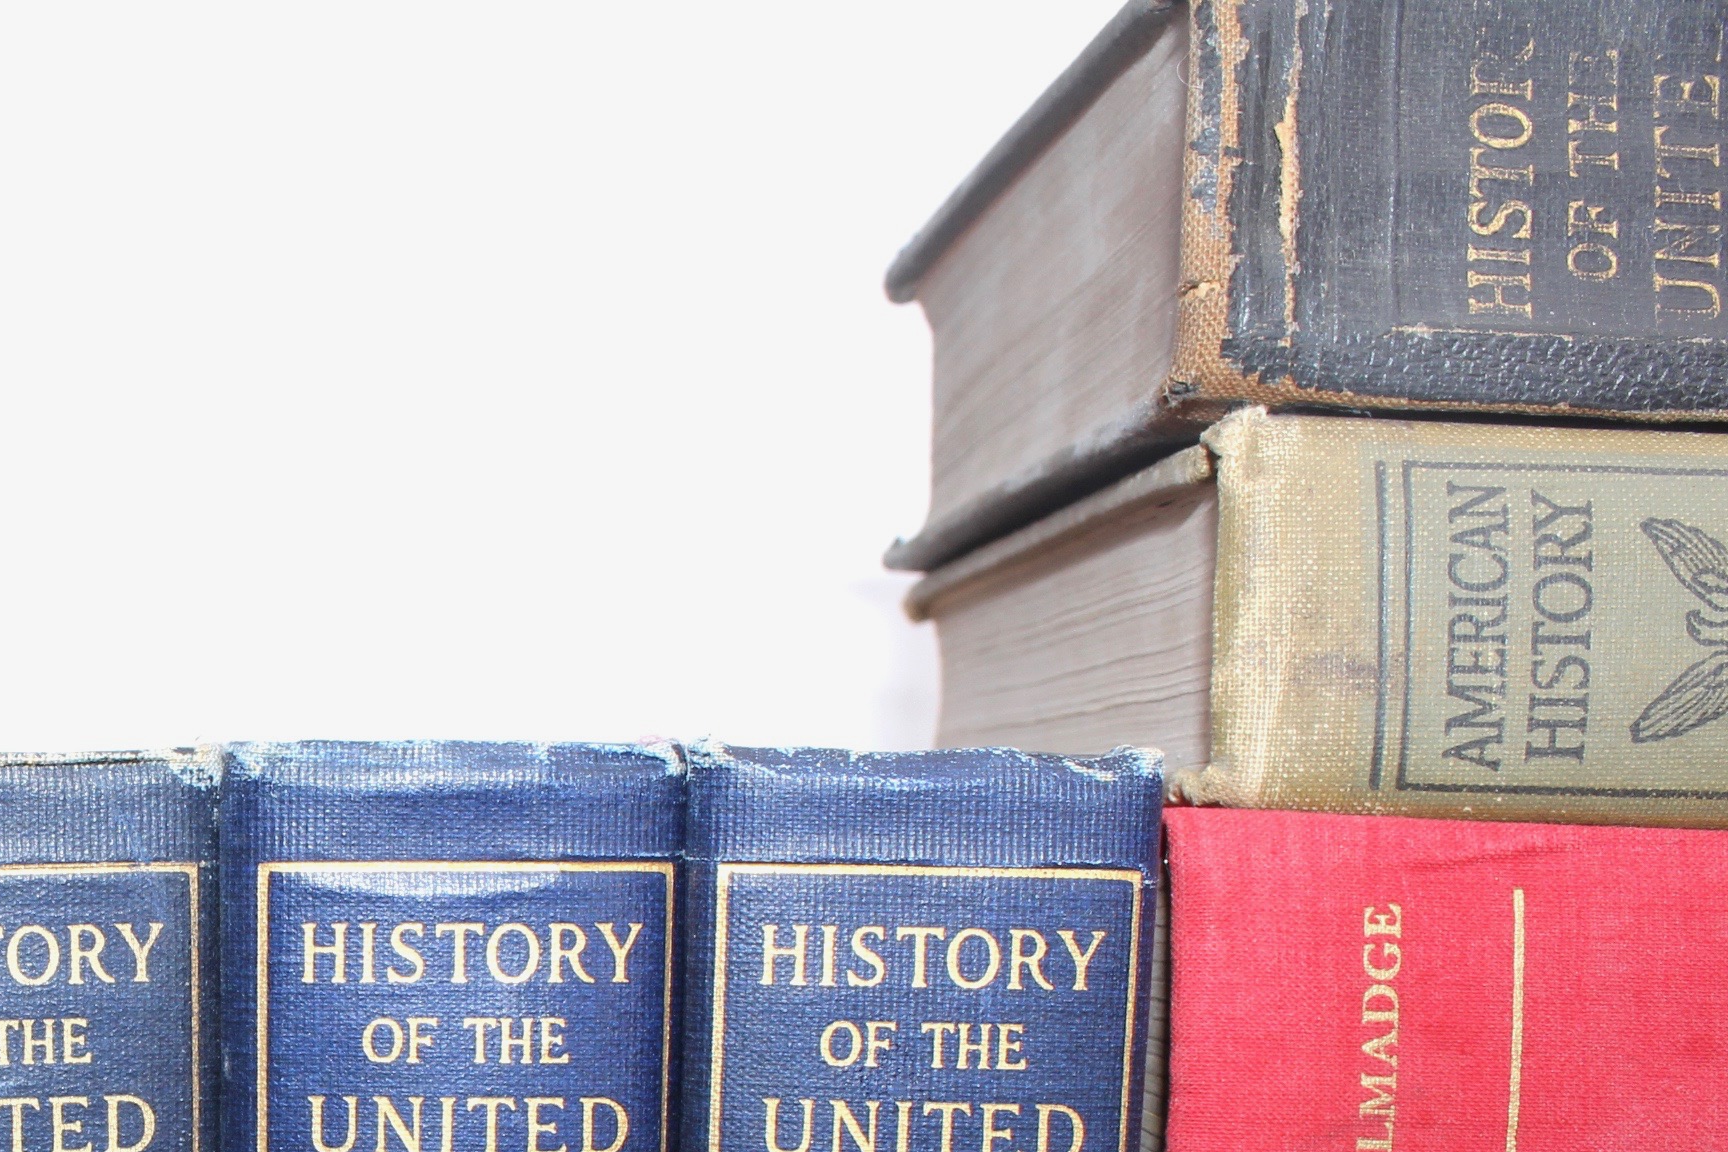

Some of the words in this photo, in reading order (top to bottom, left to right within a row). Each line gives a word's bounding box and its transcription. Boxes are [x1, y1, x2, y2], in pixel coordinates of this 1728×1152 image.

[1567, 48, 1620, 178] THE
[1467, 34, 1535, 320] HISTOR
[1652, 22, 1722, 318] UNITE
[1567, 200, 1620, 281] OF
[1441, 480, 1511, 771] AMERICAN
[1524, 488, 1594, 766] HISTORY
[304, 922, 643, 982] HISTORY
[764, 925, 1107, 990] HISTORY
[364, 1018, 438, 1061] OF
[465, 1018, 570, 1063] THE
[822, 1021, 898, 1066] OF
[924, 1022, 1028, 1069] THE
